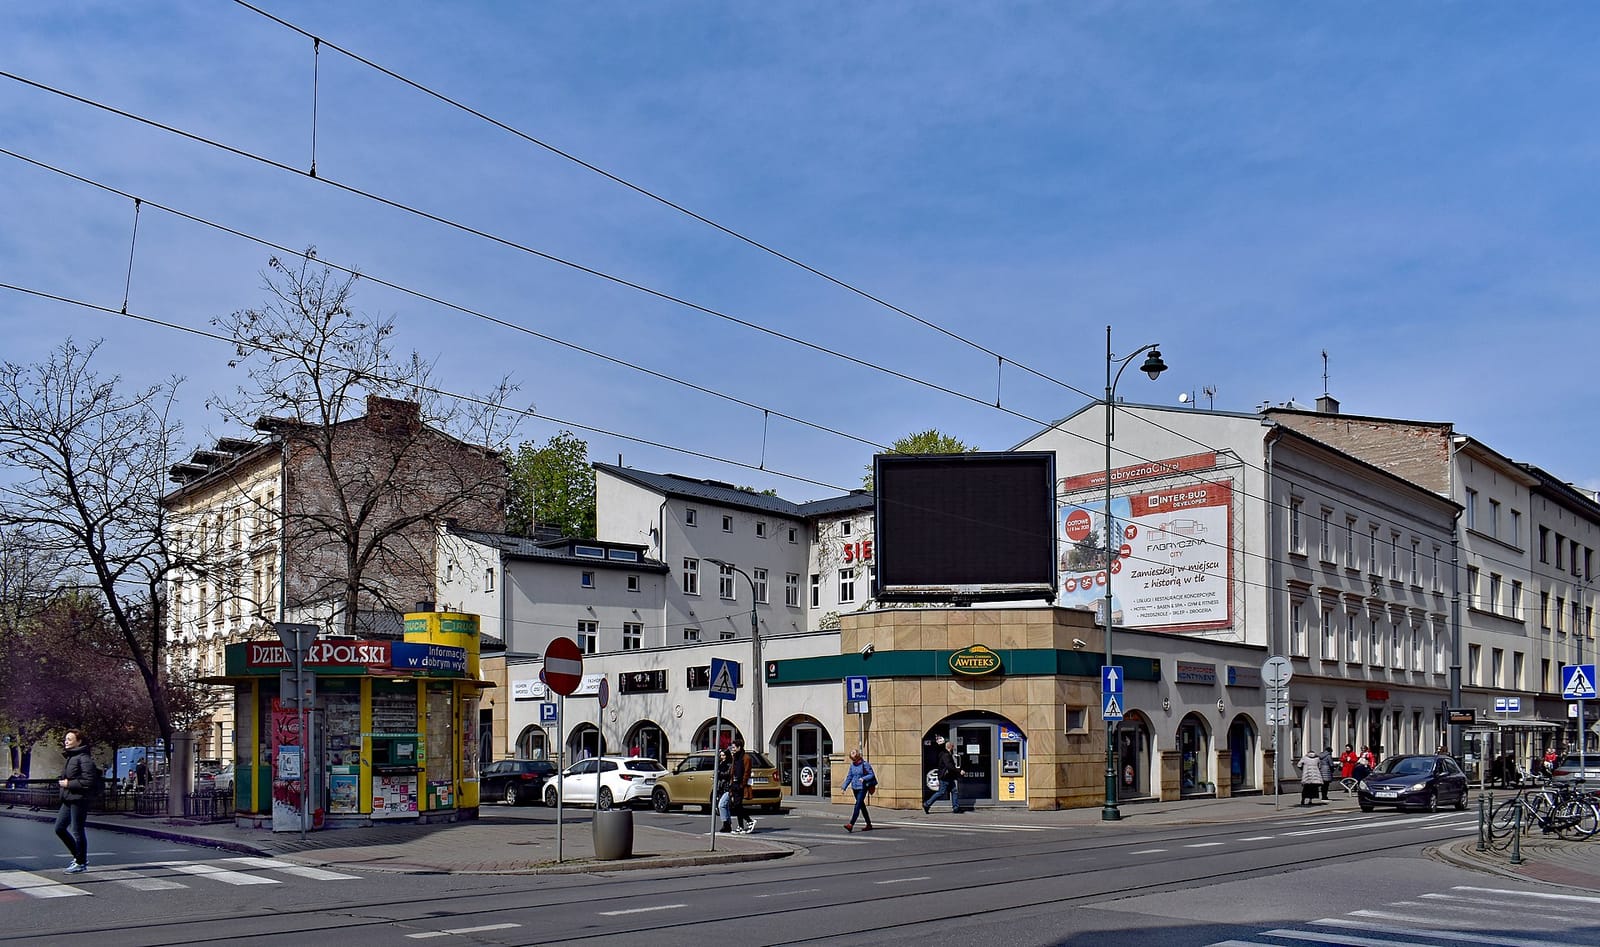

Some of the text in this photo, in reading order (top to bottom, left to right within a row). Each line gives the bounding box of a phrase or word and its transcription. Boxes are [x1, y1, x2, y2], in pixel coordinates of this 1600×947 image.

[1090, 461, 1179, 484] www.abrycznaCity.pl
[1130, 560, 1219, 579] Zamieszkaj w miejscu
[1151, 576, 1182, 588] historią
[1194, 573, 1206, 583] tle
[252, 643, 385, 664] DZIENK POLSKI
[408, 657, 418, 666] w
[421, 656, 451, 669] dobrym
[954, 658, 995, 667] AWITEKS
